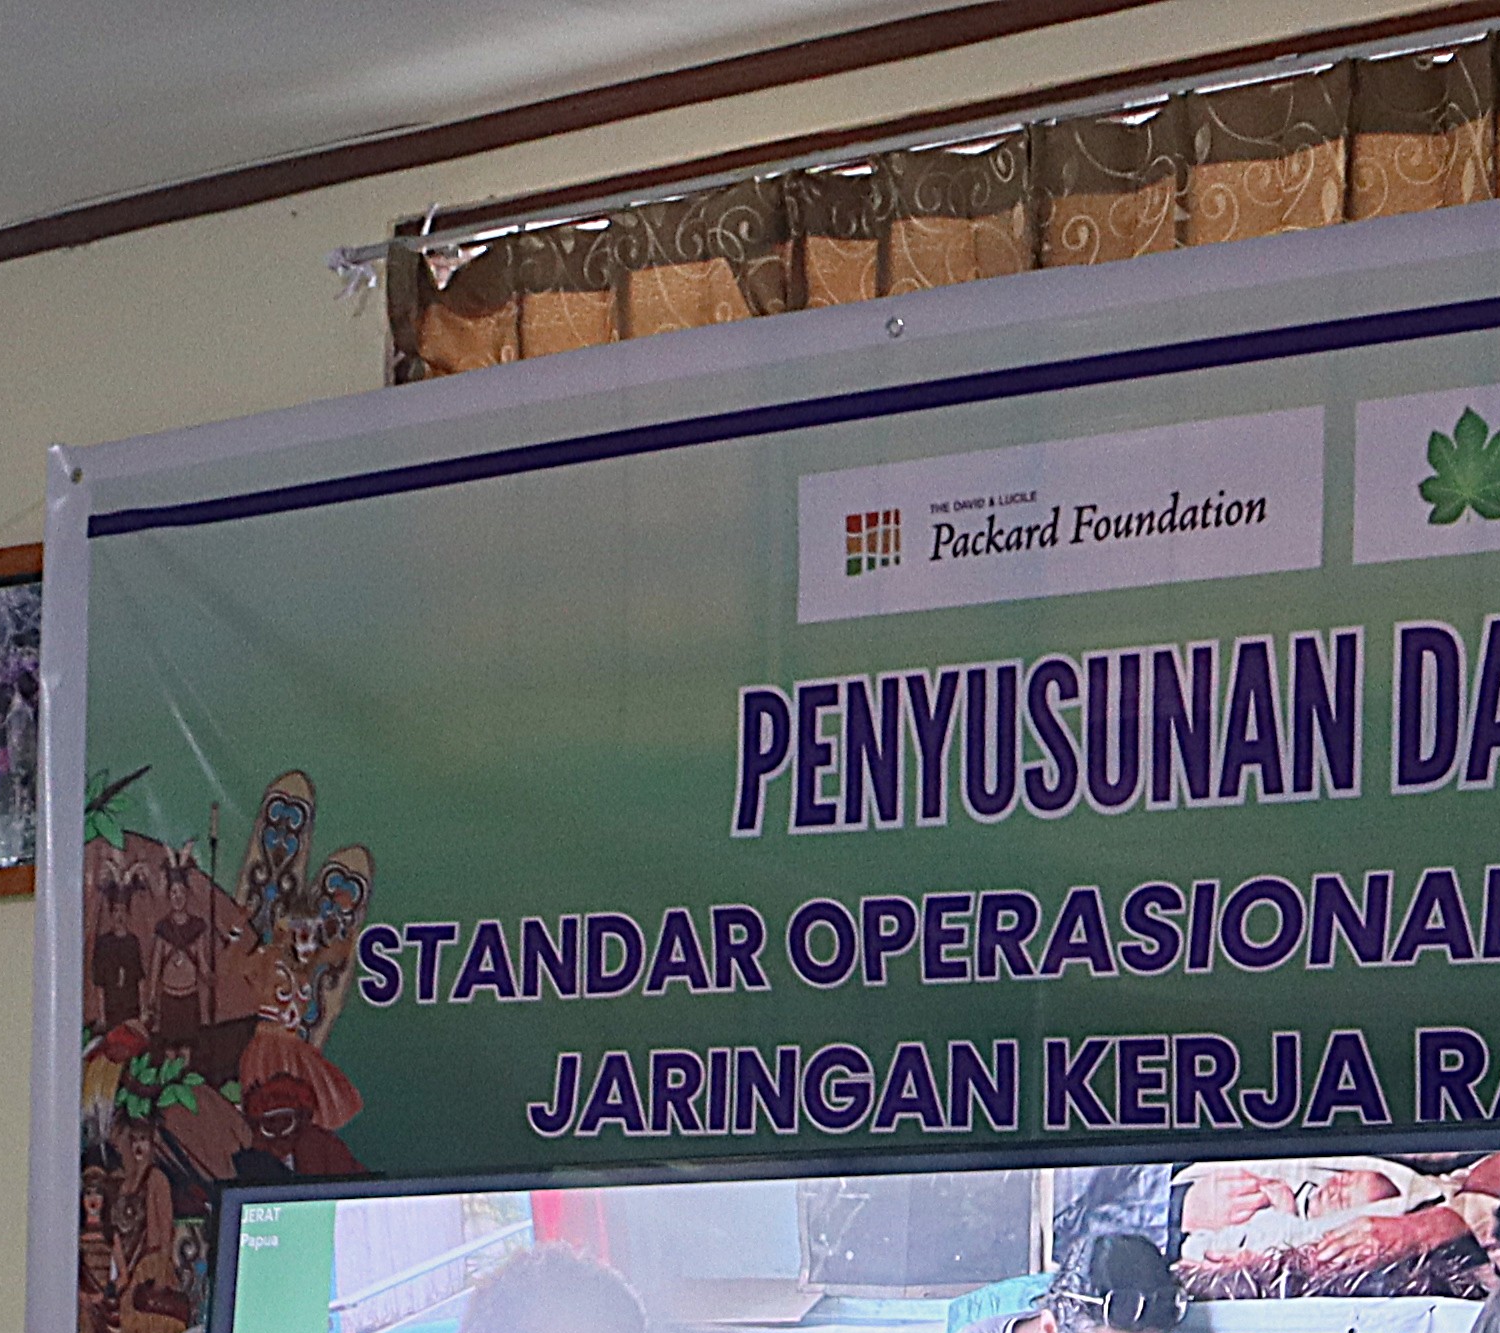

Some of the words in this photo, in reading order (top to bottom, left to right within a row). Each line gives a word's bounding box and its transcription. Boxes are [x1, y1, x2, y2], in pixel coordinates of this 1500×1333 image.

[930, 507, 1059, 561] Packard
[1069, 490, 1267, 546] Foundation
[953, 498, 985, 512] DAVID
[998, 491, 1037, 506] LUCILE
[731, 626, 1364, 838] PENYUSUNAN
[357, 903, 771, 1006] STANDAR
[527, 1039, 1018, 1137] JARINGAN
[1042, 1028, 1391, 1131] KERJA
[239, 1233, 279, 1251] Papua
[241, 1207, 281, 1224] JERAT
